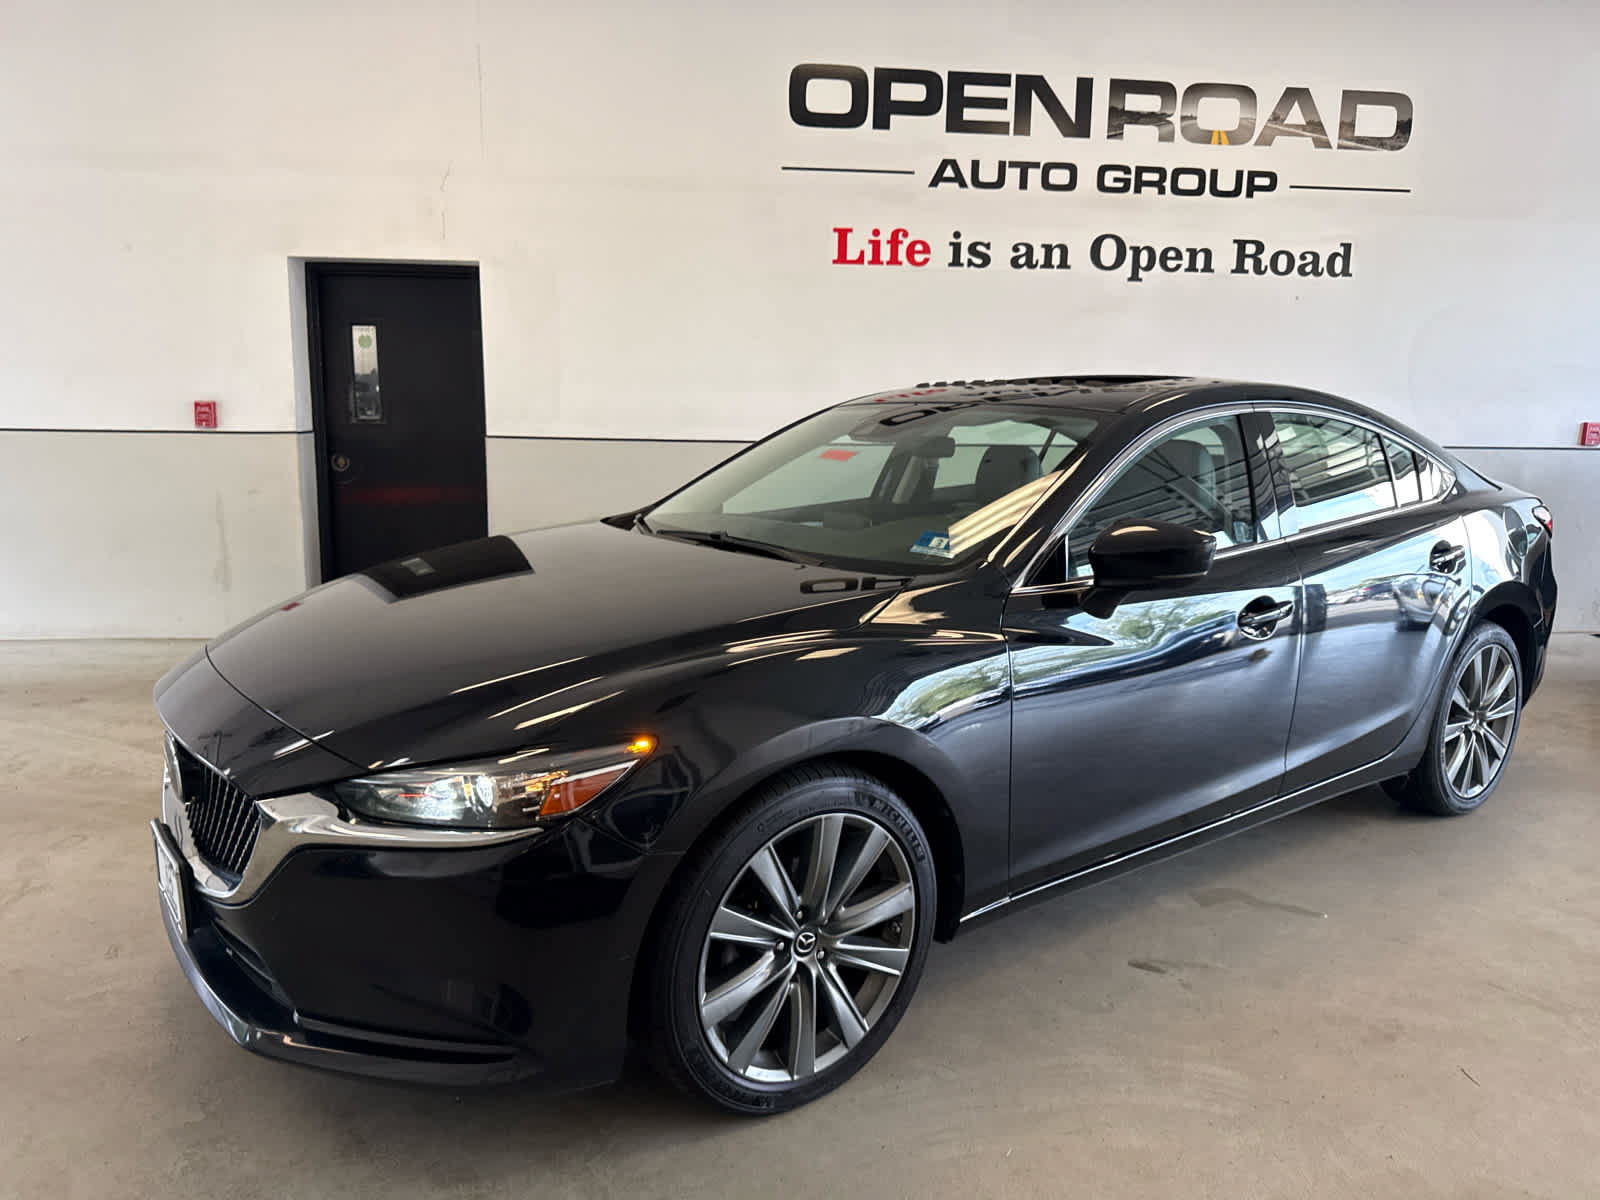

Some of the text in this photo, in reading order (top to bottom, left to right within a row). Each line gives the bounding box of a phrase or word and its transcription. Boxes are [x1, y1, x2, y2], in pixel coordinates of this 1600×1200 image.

[788, 63, 1414, 152] OPEN ROAD
[928, 158, 1278, 199] AUTO GROUP
[831, 227, 1353, 282] Life is an Open Road
